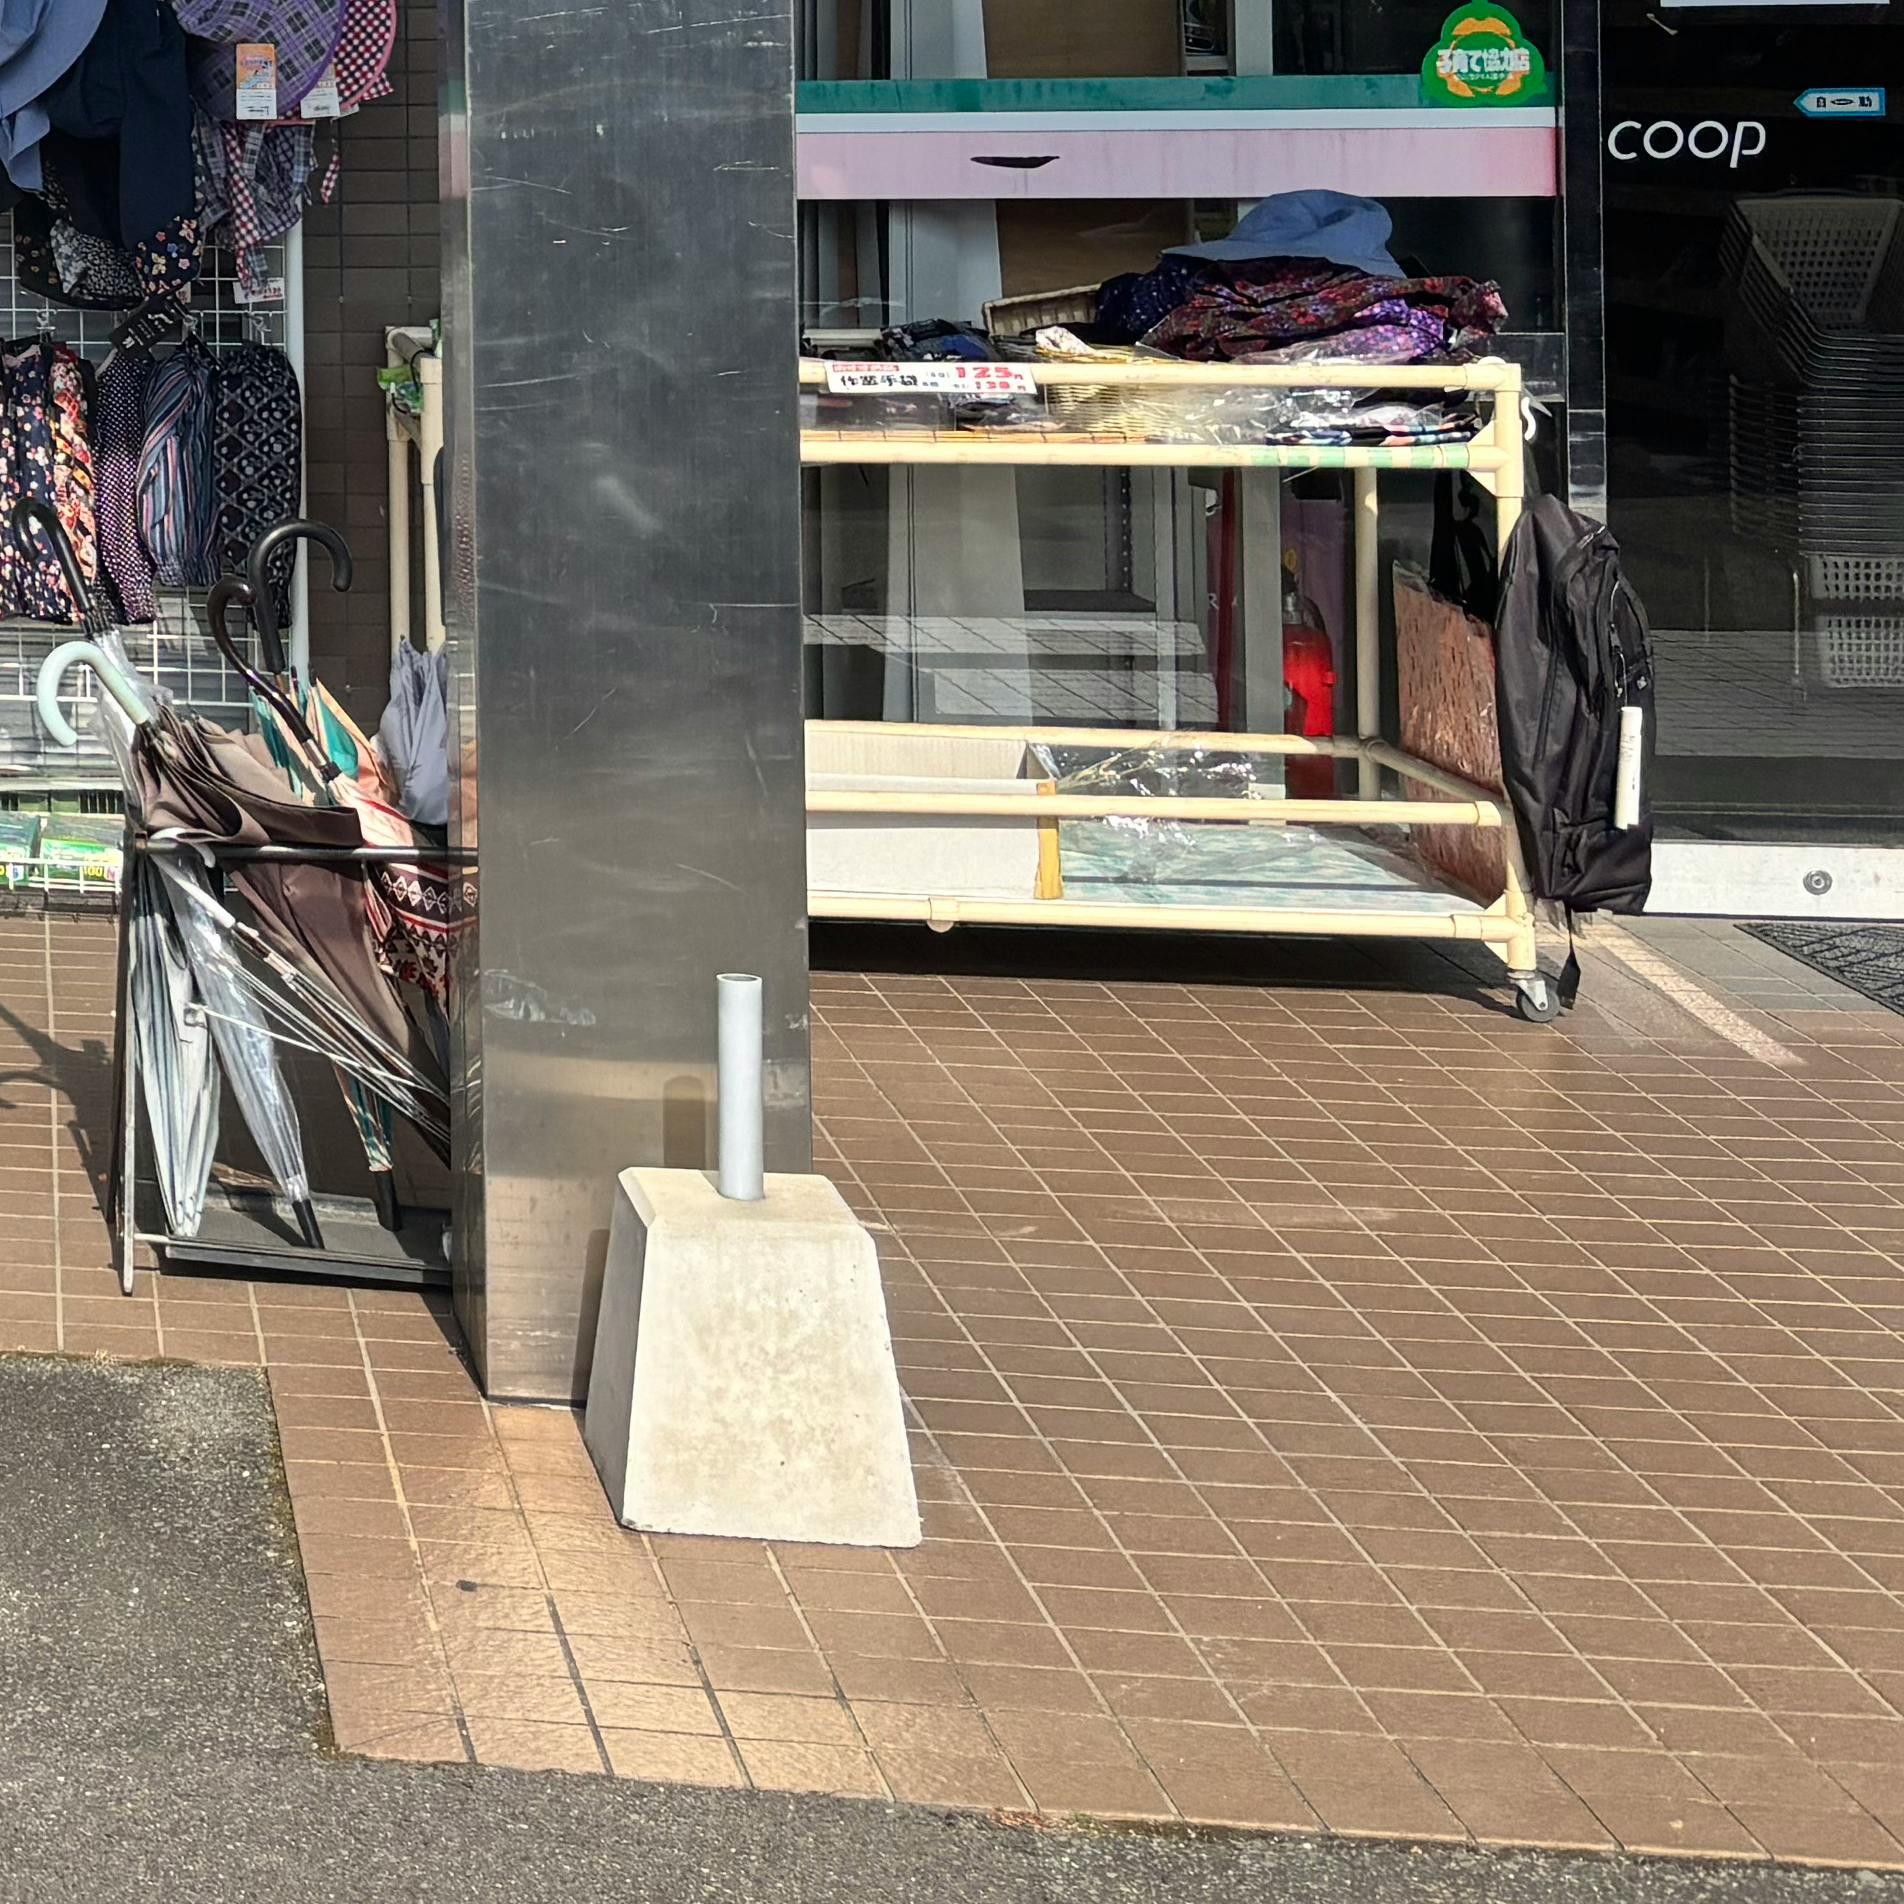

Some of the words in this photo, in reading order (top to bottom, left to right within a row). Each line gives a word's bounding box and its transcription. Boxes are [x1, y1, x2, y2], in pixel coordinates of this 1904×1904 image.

[1436, 47, 1531, 73] 子育て協力店
